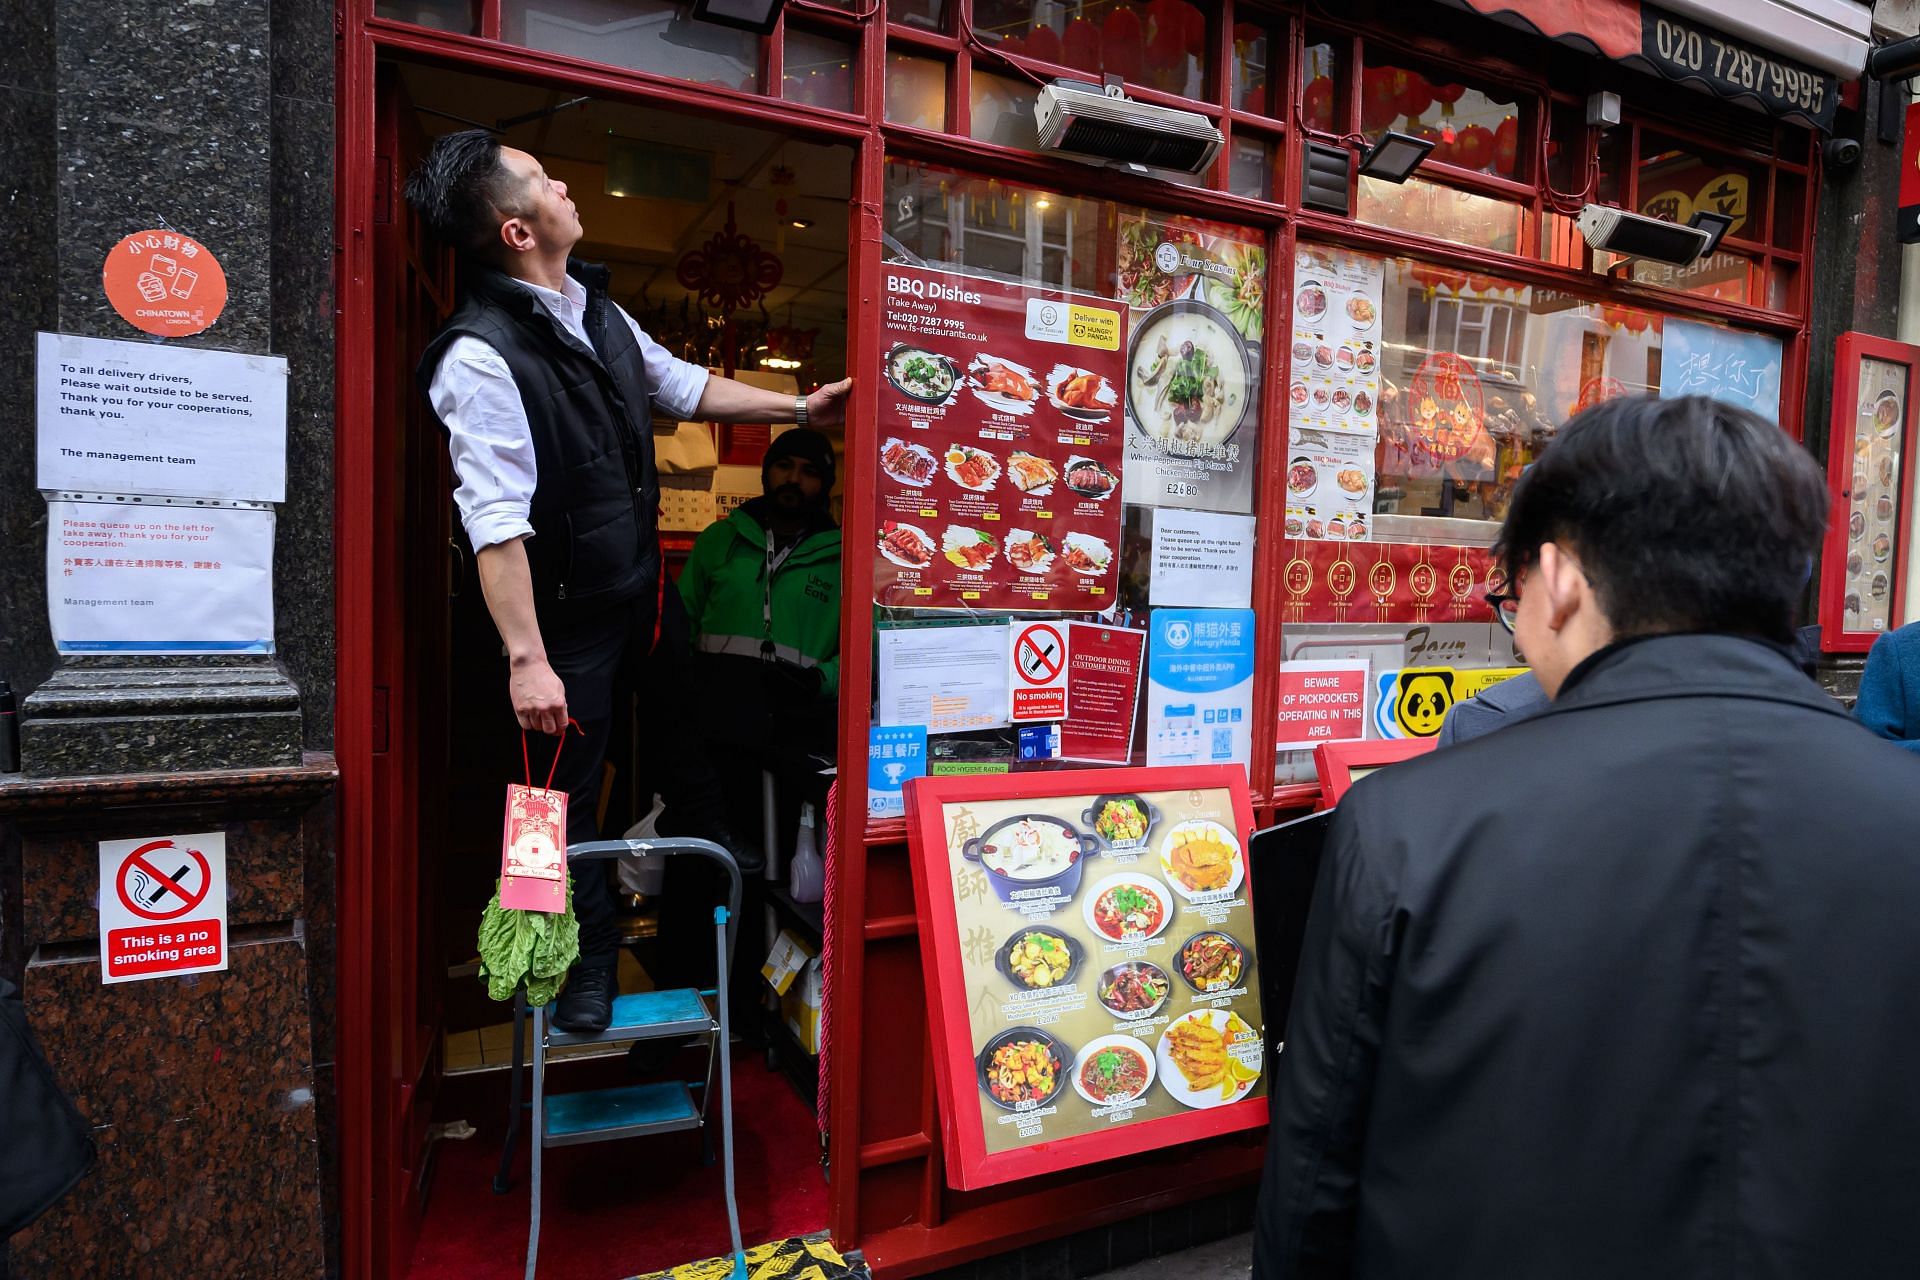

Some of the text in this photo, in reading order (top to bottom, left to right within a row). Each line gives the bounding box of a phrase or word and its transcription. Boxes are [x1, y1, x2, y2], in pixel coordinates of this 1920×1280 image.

[1657, 19, 1702, 71] 020
[128, 235, 199, 259] 小心财物
[1180, 254, 1237, 276] Four Seasons
[887, 276, 981, 305] BBQ Dishes
[887, 296, 937, 313] (Take Away)
[135, 310, 190, 318] CHINATOWN
[887, 311, 965, 330] Tel:020 7287 9995
[1074, 312, 1114, 326] Deliver with
[886, 320, 988, 343] www.fs-restaurants.co.uk
[1088, 327, 1113, 336] HUNGRY
[1088, 333, 1108, 342] PANDA
[60, 364, 193, 385] To all delivery drivers,
[61, 378, 253, 403] Please wait outside to be served.
[60, 392, 253, 417] Thank you for your cooperations,
[60, 406, 125, 419] thank you.
[60, 448, 196, 465] The management team
[1130, 452, 1152, 464] White
[1194, 458, 1206, 470] Pig
[1155, 466, 1210, 481] Chicken Hot Pot
[63, 520, 96, 528] Please
[100, 522, 130, 530] queue
[134, 523, 146, 531] up
[182, 524, 198, 532] left
[201, 524, 215, 532] for
[63, 540, 127, 548] cooperation.
[120, 532, 147, 540] thank
[808, 573, 833, 591] Uber
[804, 584, 829, 603] Eats
[64, 598, 128, 607] Management
[1194, 622, 1241, 639] 熊猫外卖
[1193, 639, 1241, 649] HungryPanda
[1404, 626, 1466, 664] Four
[1072, 660, 1130, 673] CUSTOMER NOTICE
[1075, 654, 1131, 667] OUTDOOR DINING
[1304, 678, 1340, 688] BEWARE
[1016, 691, 1063, 701] No smoking
[1283, 692, 1359, 705] OF PICKPOCKETS
[1280, 708, 1362, 721] OPERATING IN THIS
[1308, 726, 1332, 737] AREA
[869, 742, 921, 759] 明星餐厅
[937, 765, 1005, 773] FOOD HYGIENE RATING
[121, 932, 209, 949] This is a no
[114, 945, 216, 965] smoking area
